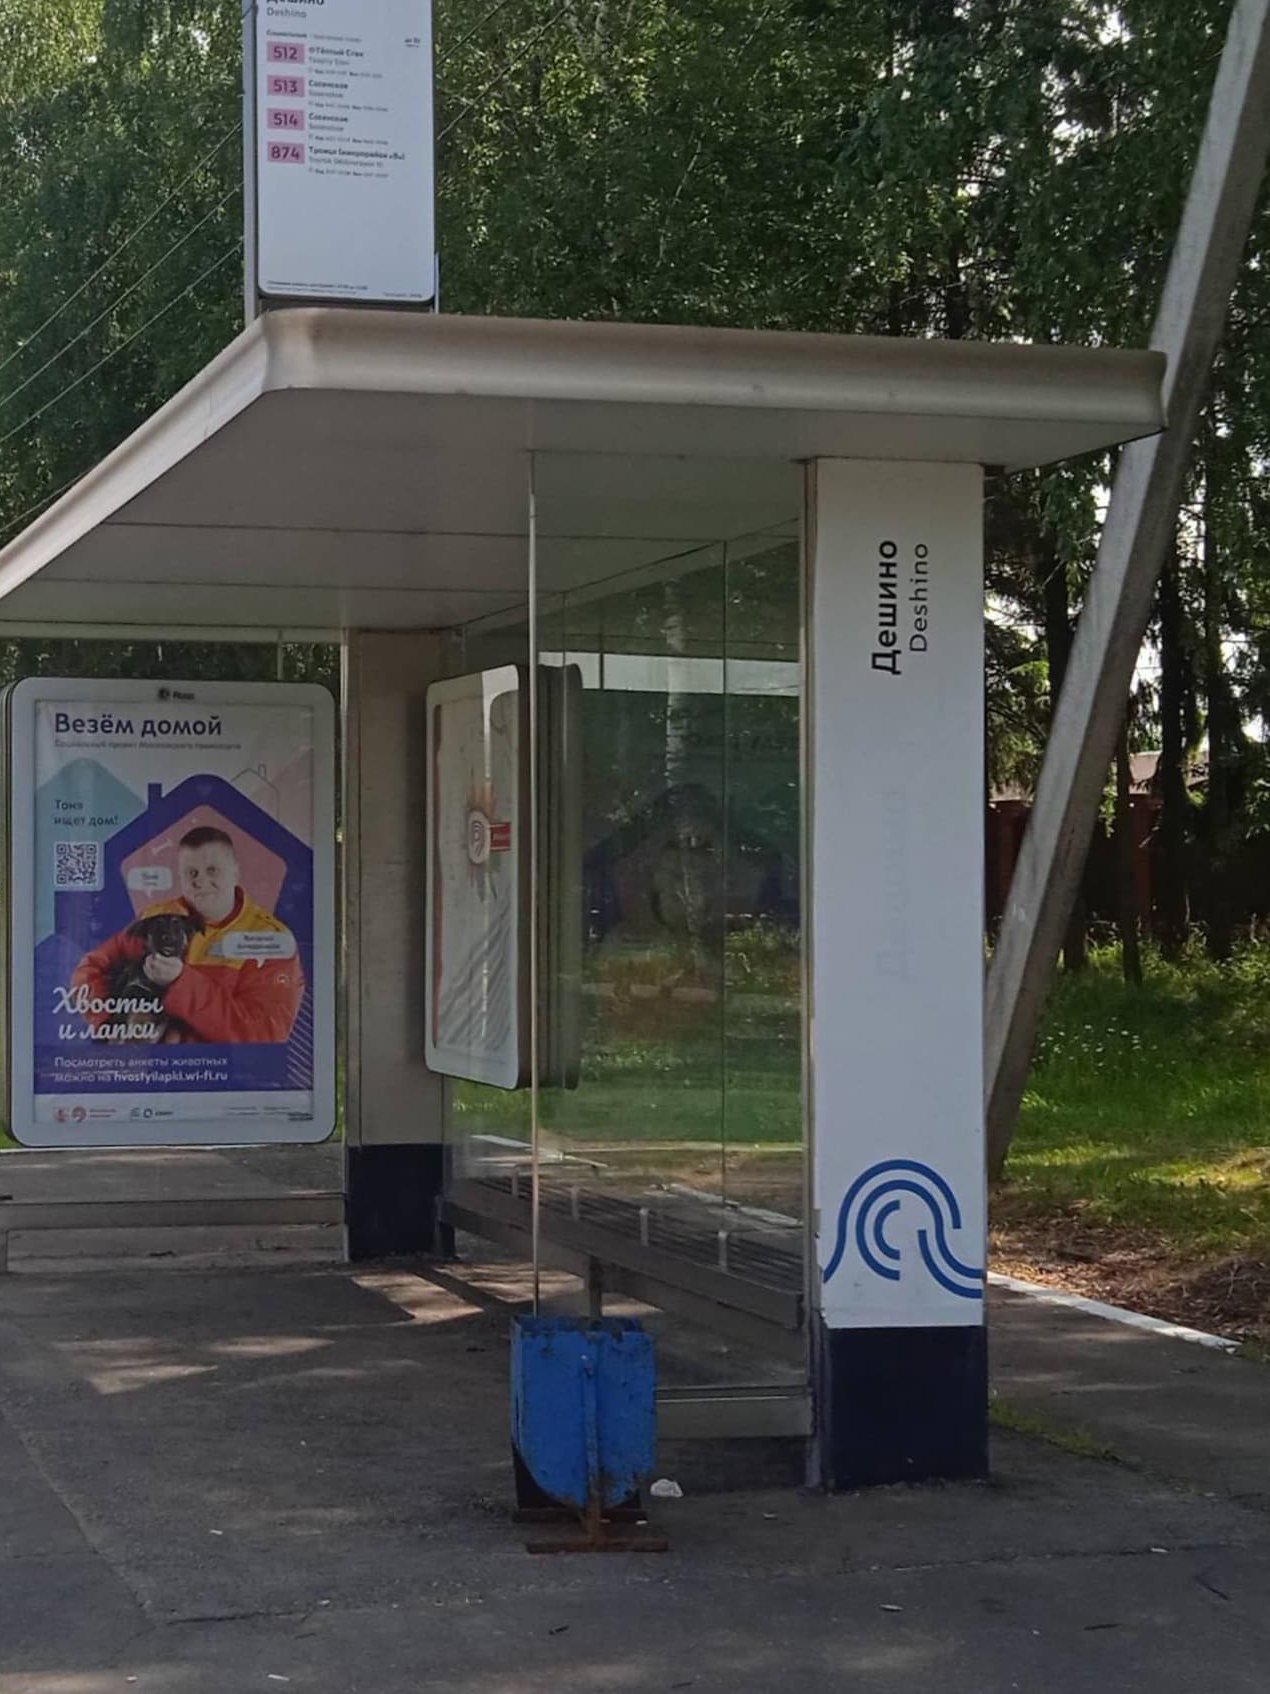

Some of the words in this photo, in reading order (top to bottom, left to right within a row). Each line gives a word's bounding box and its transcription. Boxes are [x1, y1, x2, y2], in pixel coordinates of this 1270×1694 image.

[273, 46, 298, 60] 512
[273, 79, 298, 93] 513
[273, 112, 298, 126] 514
[271, 145, 299, 160] 874
[908, 543, 928, 652] Deshino
[871, 540, 902, 676] Дешино
[55, 713, 134, 735] Везём
[141, 715, 222, 737] домой
[54, 817, 85, 826] ищет
[89, 815, 119, 827] дом!
[52, 984, 164, 1014] Хвосты
[58, 1023, 77, 1040] и
[80, 1022, 160, 1041] лапки
[54, 1056, 126, 1069] Посмотреть
[128, 1057, 169, 1067] анкеты
[171, 1058, 228, 1067] животных
[54, 1072, 95, 1082] можно
